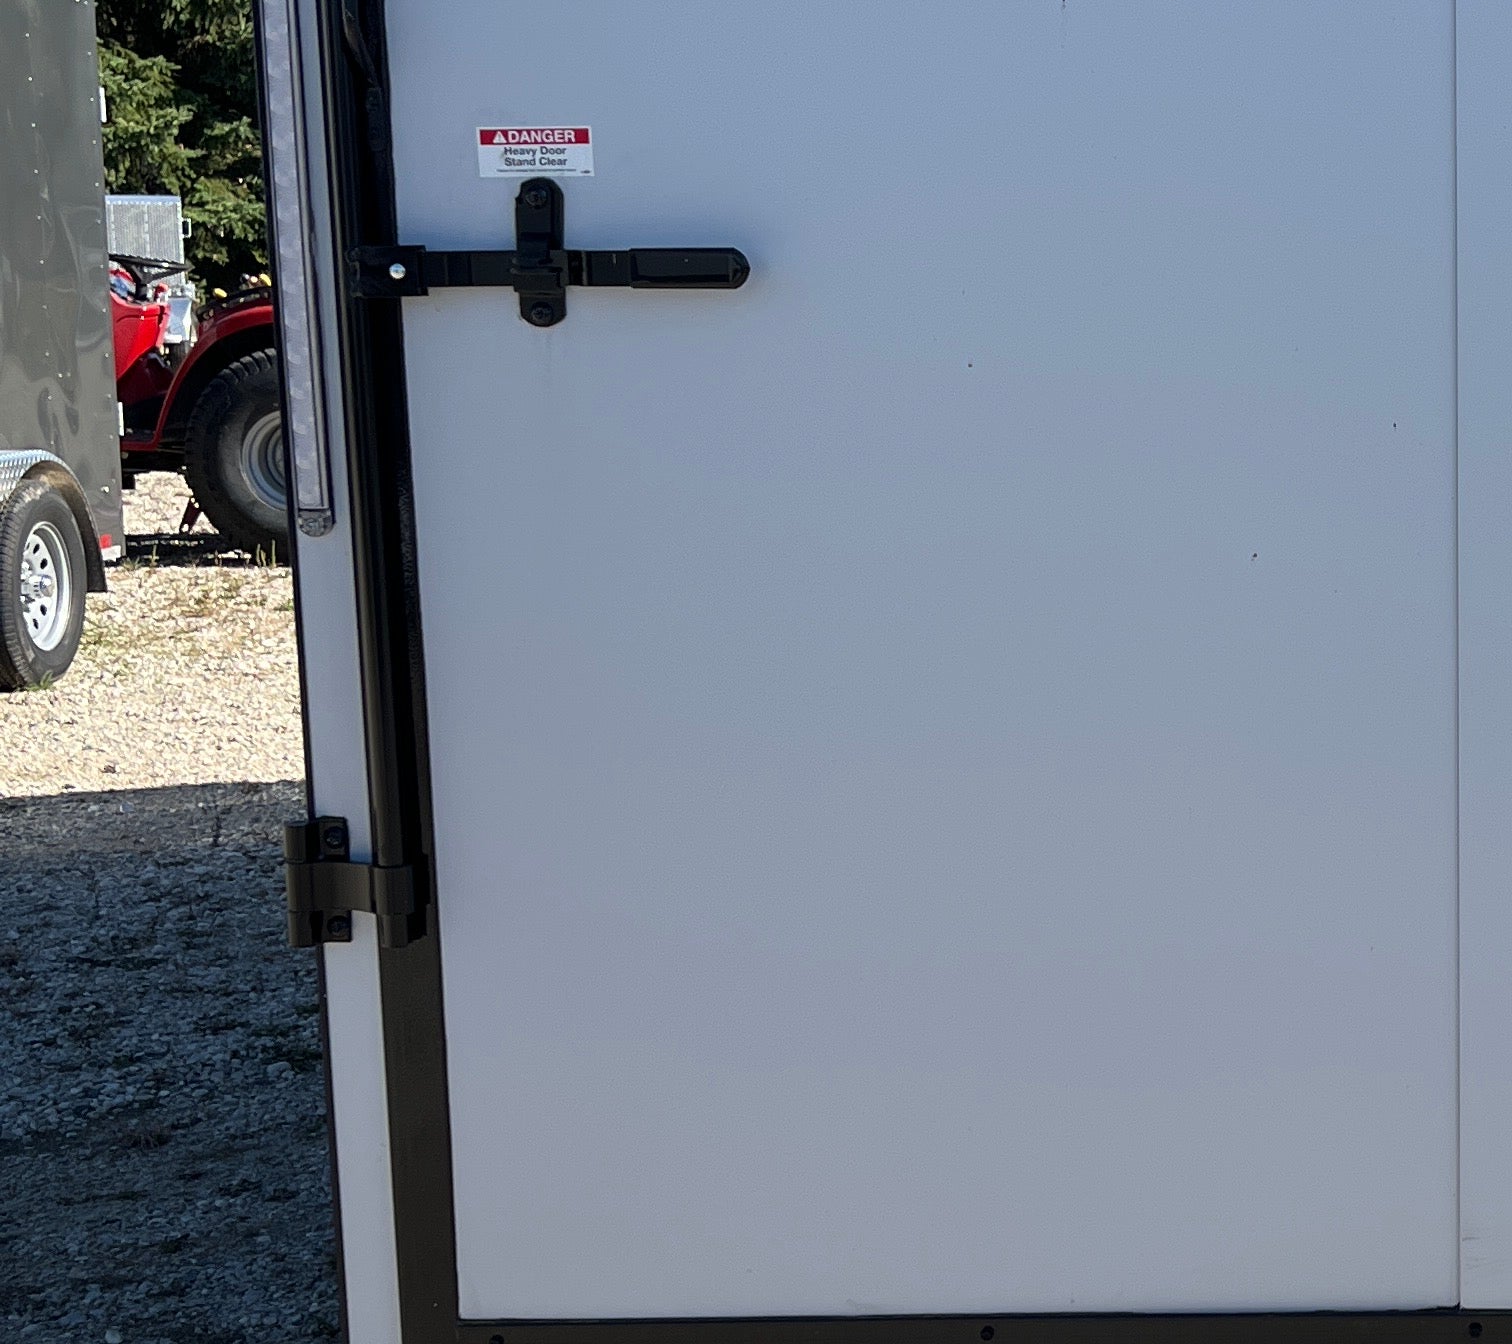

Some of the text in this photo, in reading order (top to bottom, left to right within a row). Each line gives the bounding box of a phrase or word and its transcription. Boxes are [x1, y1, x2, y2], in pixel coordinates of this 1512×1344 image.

[507, 130, 576, 144] DANGER
[503, 146, 567, 157] Heavy Door
[504, 157, 568, 167] Stand Clear
